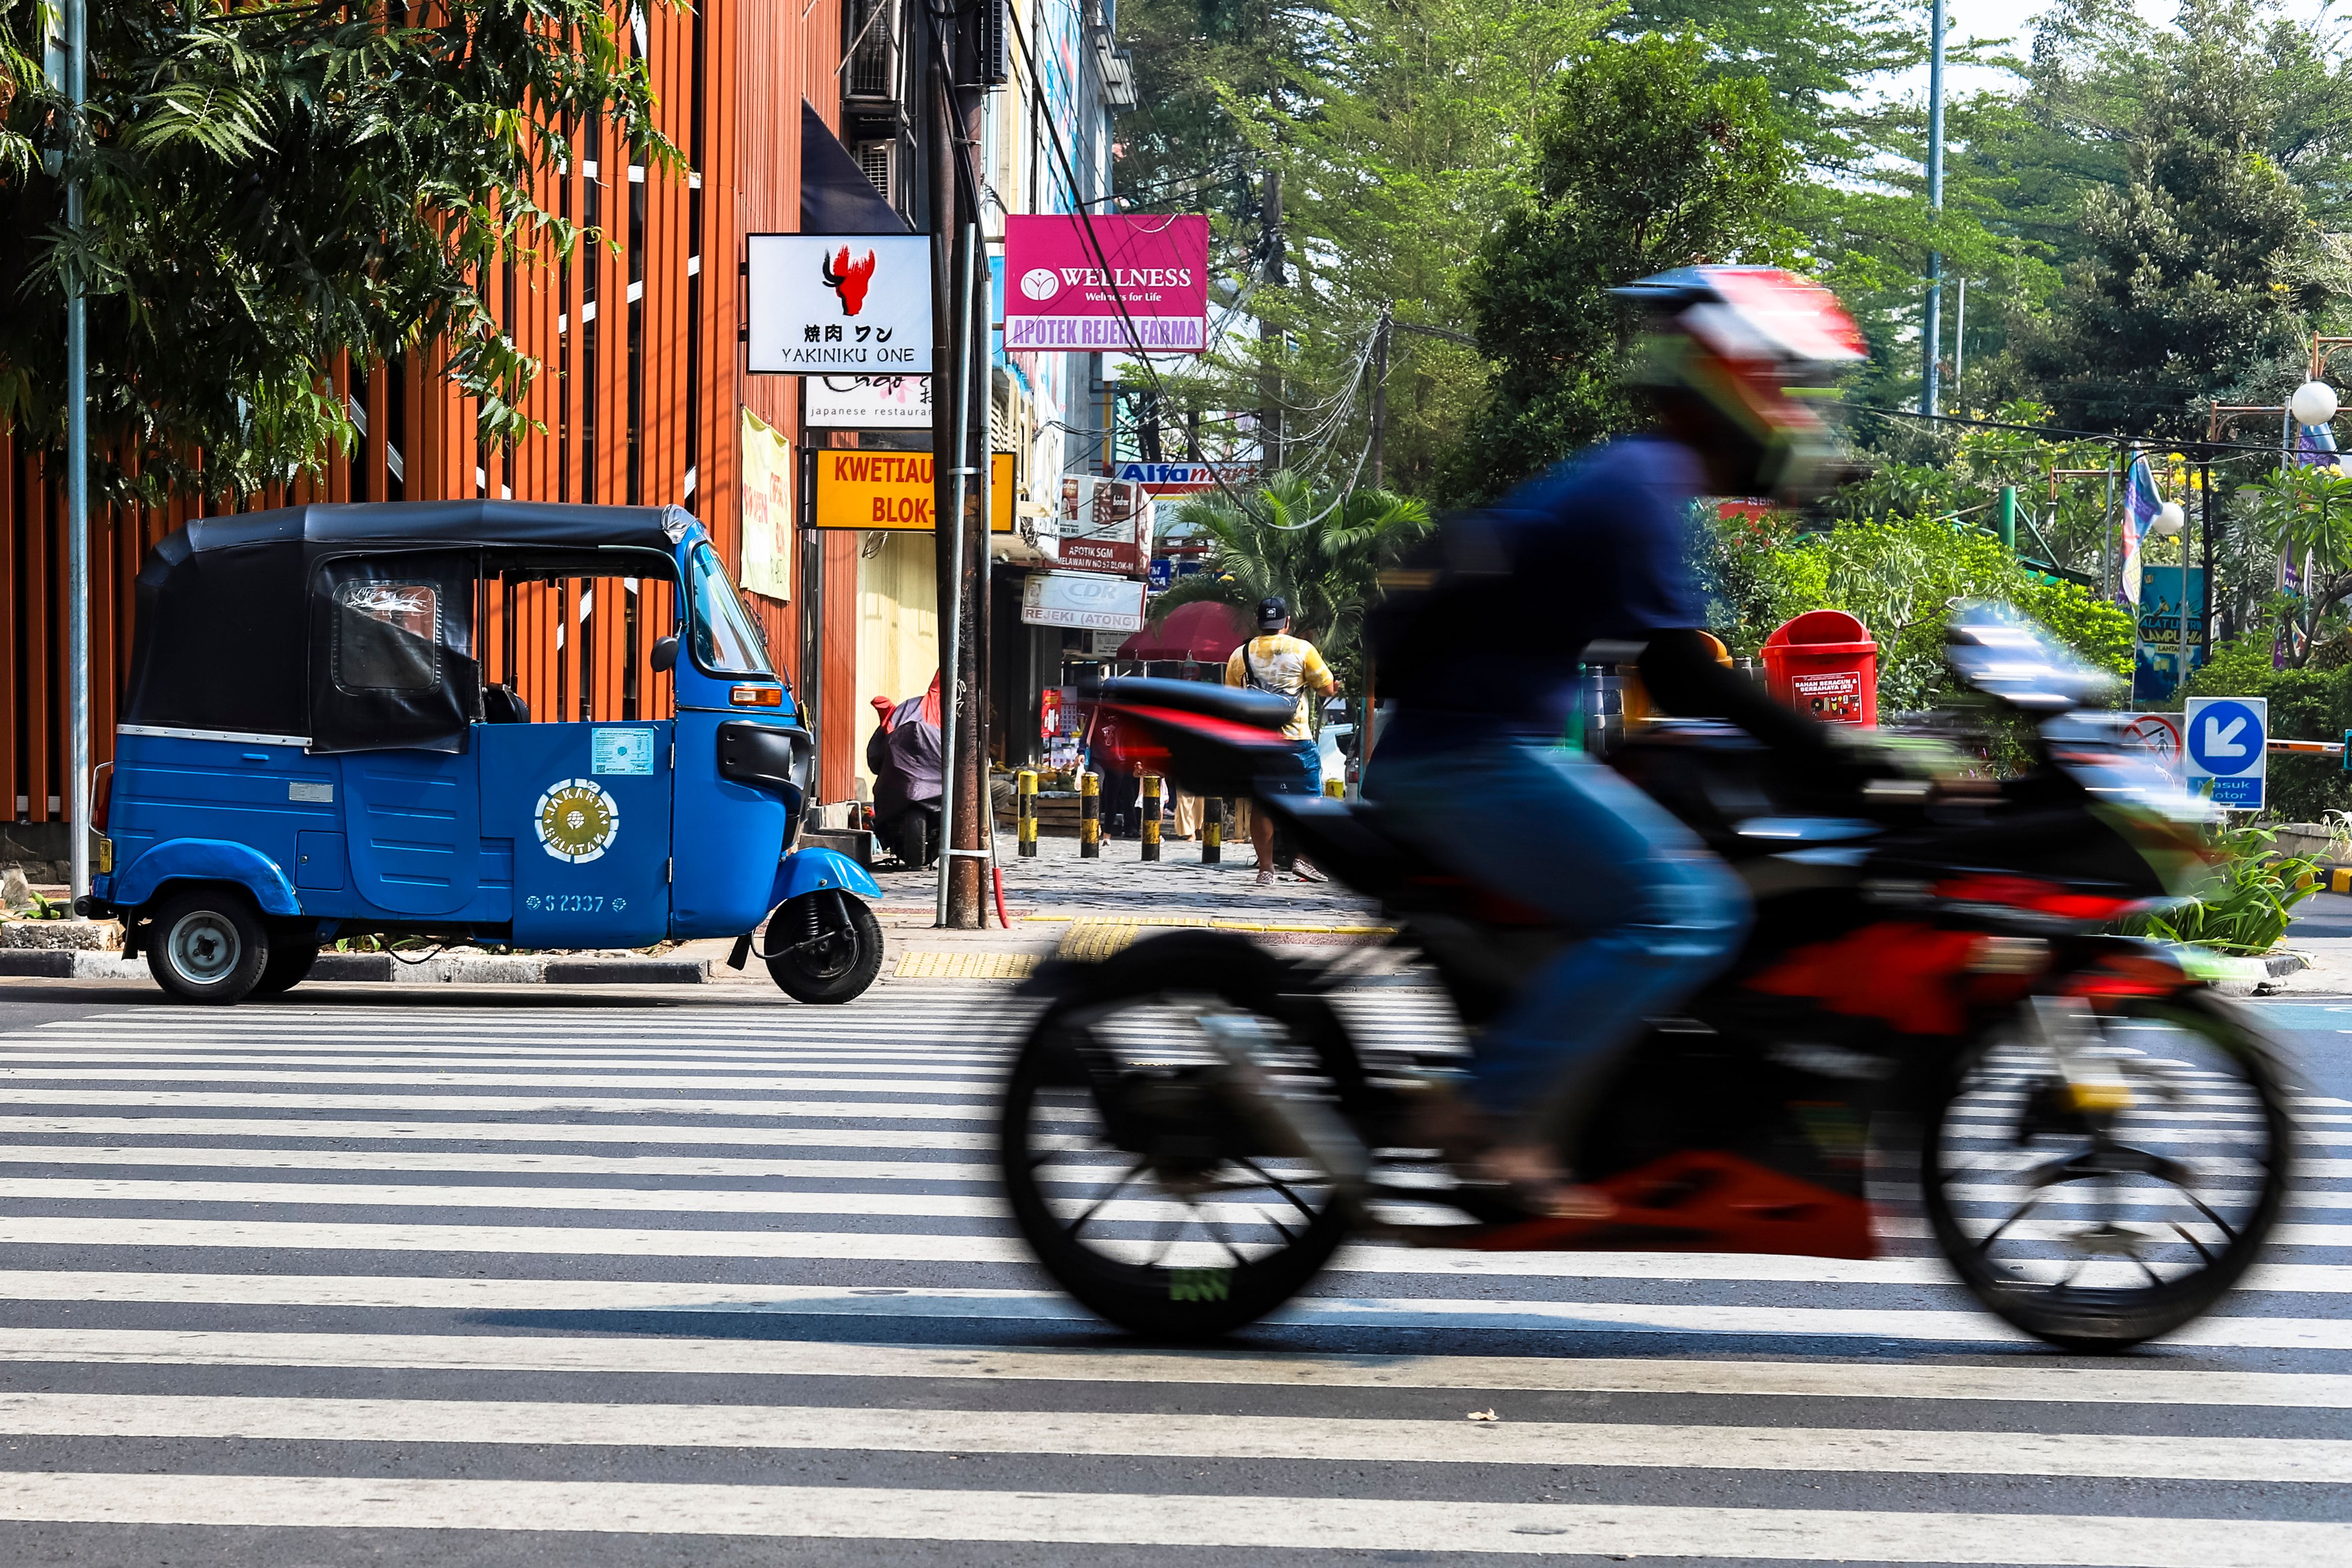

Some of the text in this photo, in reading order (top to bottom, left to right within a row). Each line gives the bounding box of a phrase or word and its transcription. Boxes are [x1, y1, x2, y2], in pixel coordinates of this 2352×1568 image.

[1060, 268, 1191, 287] WELLNESS
[1130, 292, 1143, 301] for
[1145, 292, 1162, 302] Life
[804, 324, 893, 342] 焼肉 ワン
[1013, 320, 1077, 344] APOTEK
[1141, 321, 1197, 345] FARMA
[782, 348, 914, 363] YAKINIKU ONE
[811, 407, 866, 417] japanese
[1068, 546, 1113, 558] APOTIK SGM
[1111, 562, 1133, 570] BLOK-M
[1069, 583, 1116, 599] CDR
[1025, 609, 1136, 629] REJEKI (ATONG)
[2211, 791, 2246, 799] otor
[546, 788, 608, 819] JAKARTA
[545, 827, 605, 854] SELATAN
[545, 895, 604, 912] S 2337
